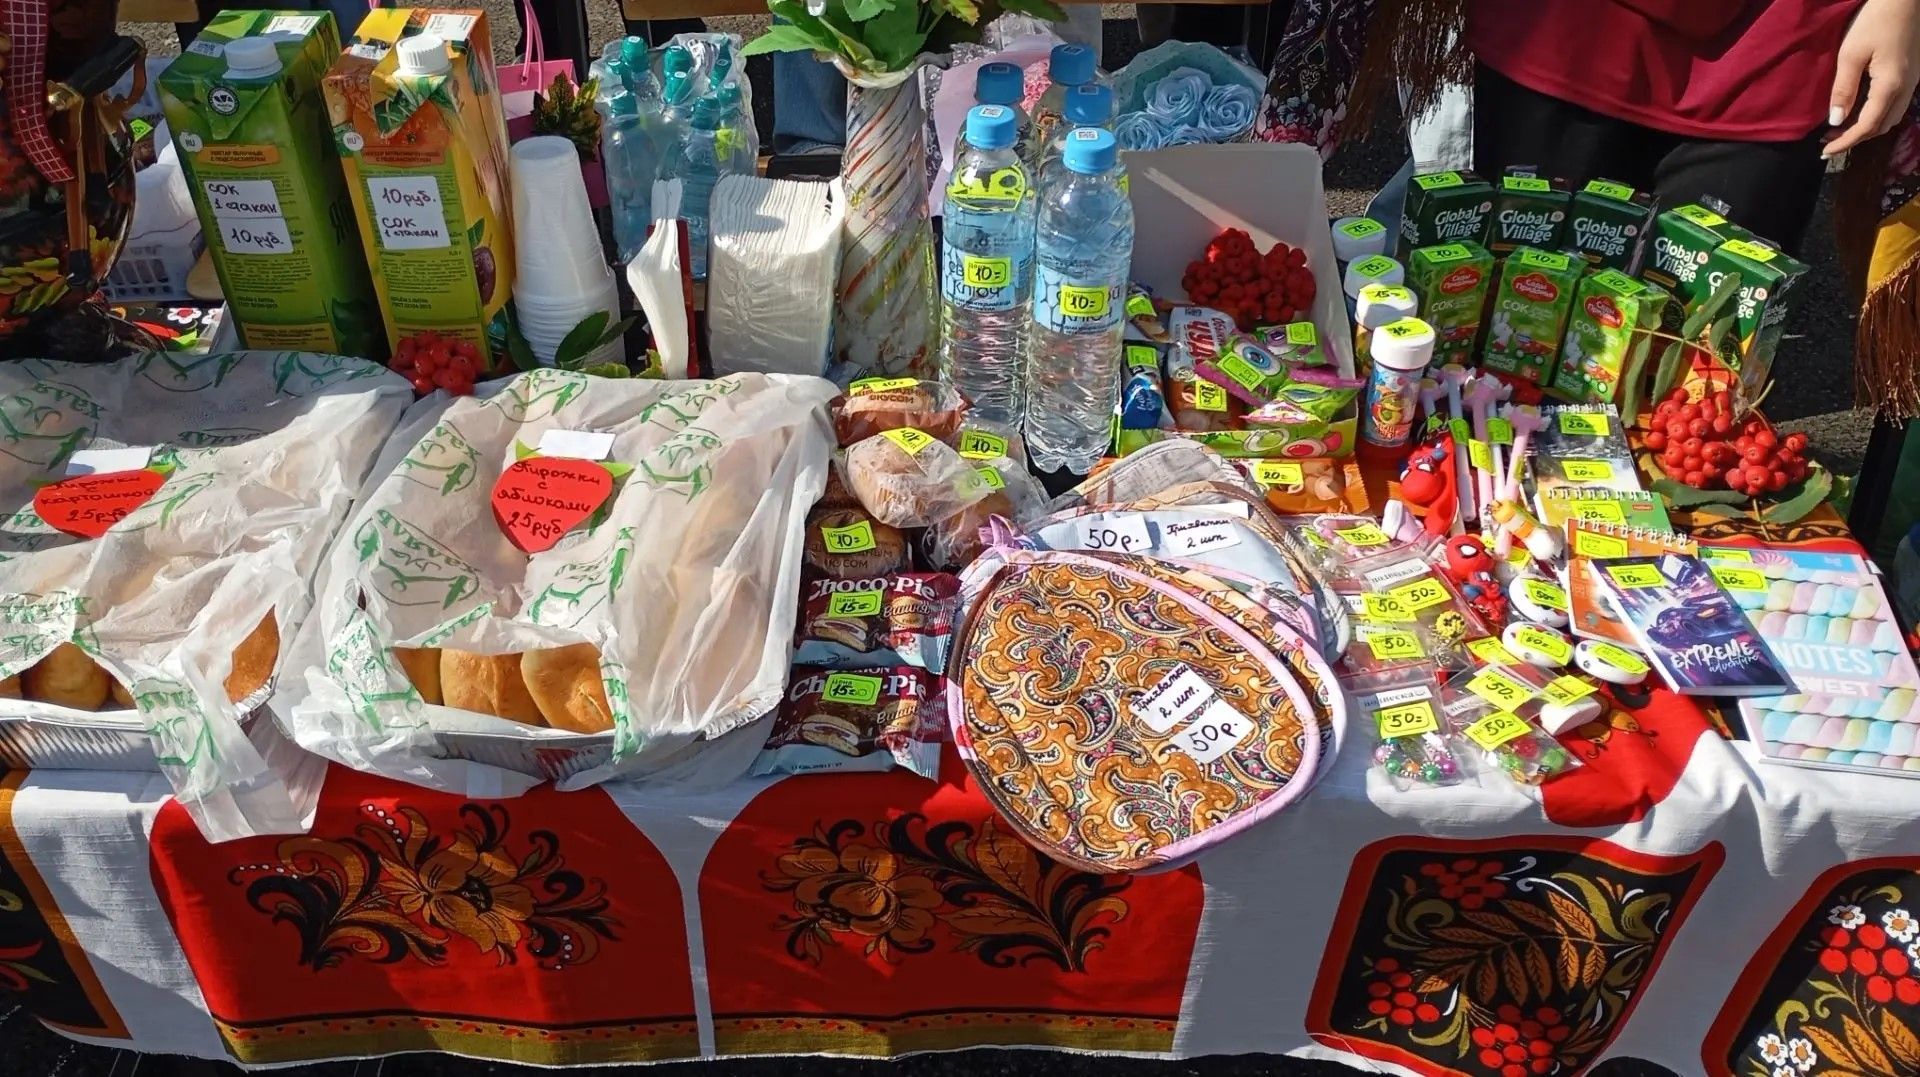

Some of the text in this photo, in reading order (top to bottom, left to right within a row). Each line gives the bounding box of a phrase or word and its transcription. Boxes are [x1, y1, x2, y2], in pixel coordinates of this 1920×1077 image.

[1434, 205, 1477, 226] Global
[1500, 209, 1549, 225] Global
[1436, 220, 1481, 240] Village
[1502, 223, 1552, 244] Village
[1573, 217, 1622, 239] Global
[1575, 231, 1625, 256] Village
[1654, 236, 1697, 265] Global
[975, 267, 1001, 281] 10=
[1655, 251, 1697, 283] Village
[1070, 296, 1097, 309] 10=
[1503, 300, 1529, 313] СОК
[1187, 536, 1197, 549] 2
[1410, 587, 1436, 602] 50=
[1377, 600, 1404, 612] 50=
[1384, 638, 1411, 649] 50=
[1670, 638, 1755, 669] EXTREME
[1486, 682, 1514, 700] 50=
[1390, 713, 1422, 727] 50=
[1484, 719, 1514, 736] 50=
